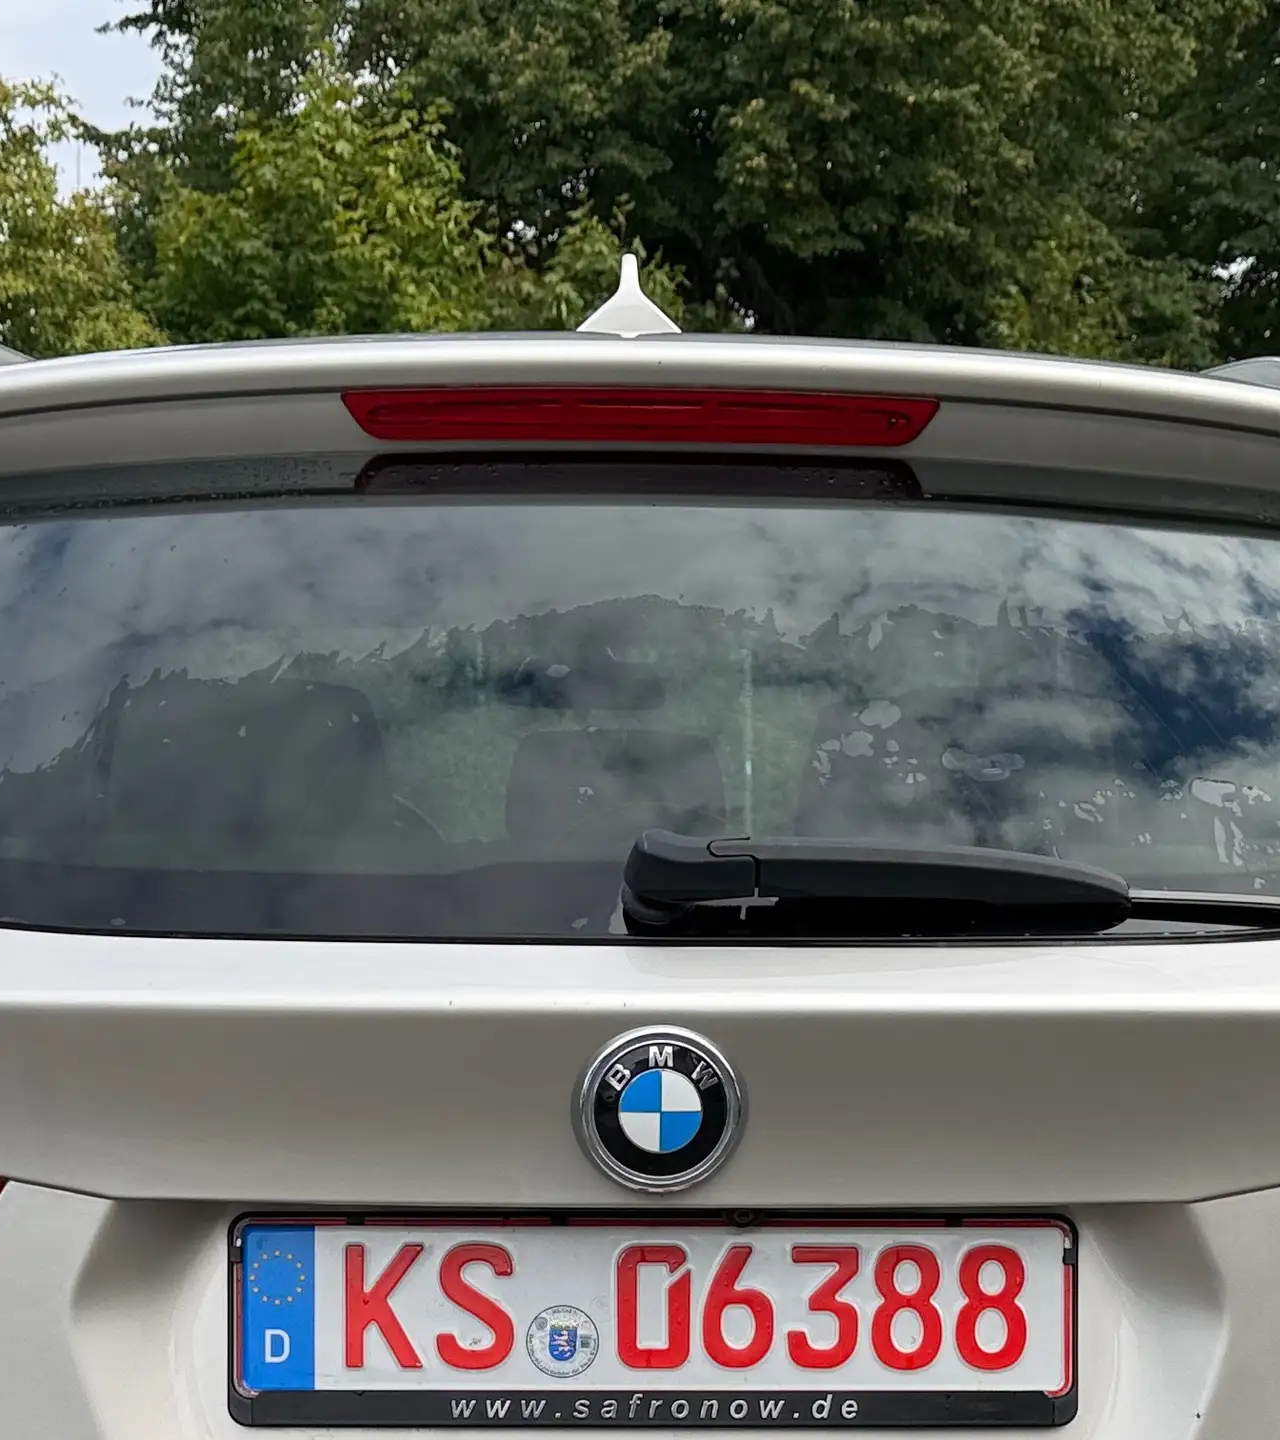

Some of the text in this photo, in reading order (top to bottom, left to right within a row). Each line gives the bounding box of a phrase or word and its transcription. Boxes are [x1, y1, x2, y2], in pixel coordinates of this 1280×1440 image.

[604, 1045, 719, 1092] BMW
[344, 1242, 1028, 1372] KS 06388
[265, 1329, 291, 1364] D
[449, 1394, 860, 1420] www.safronow.de
